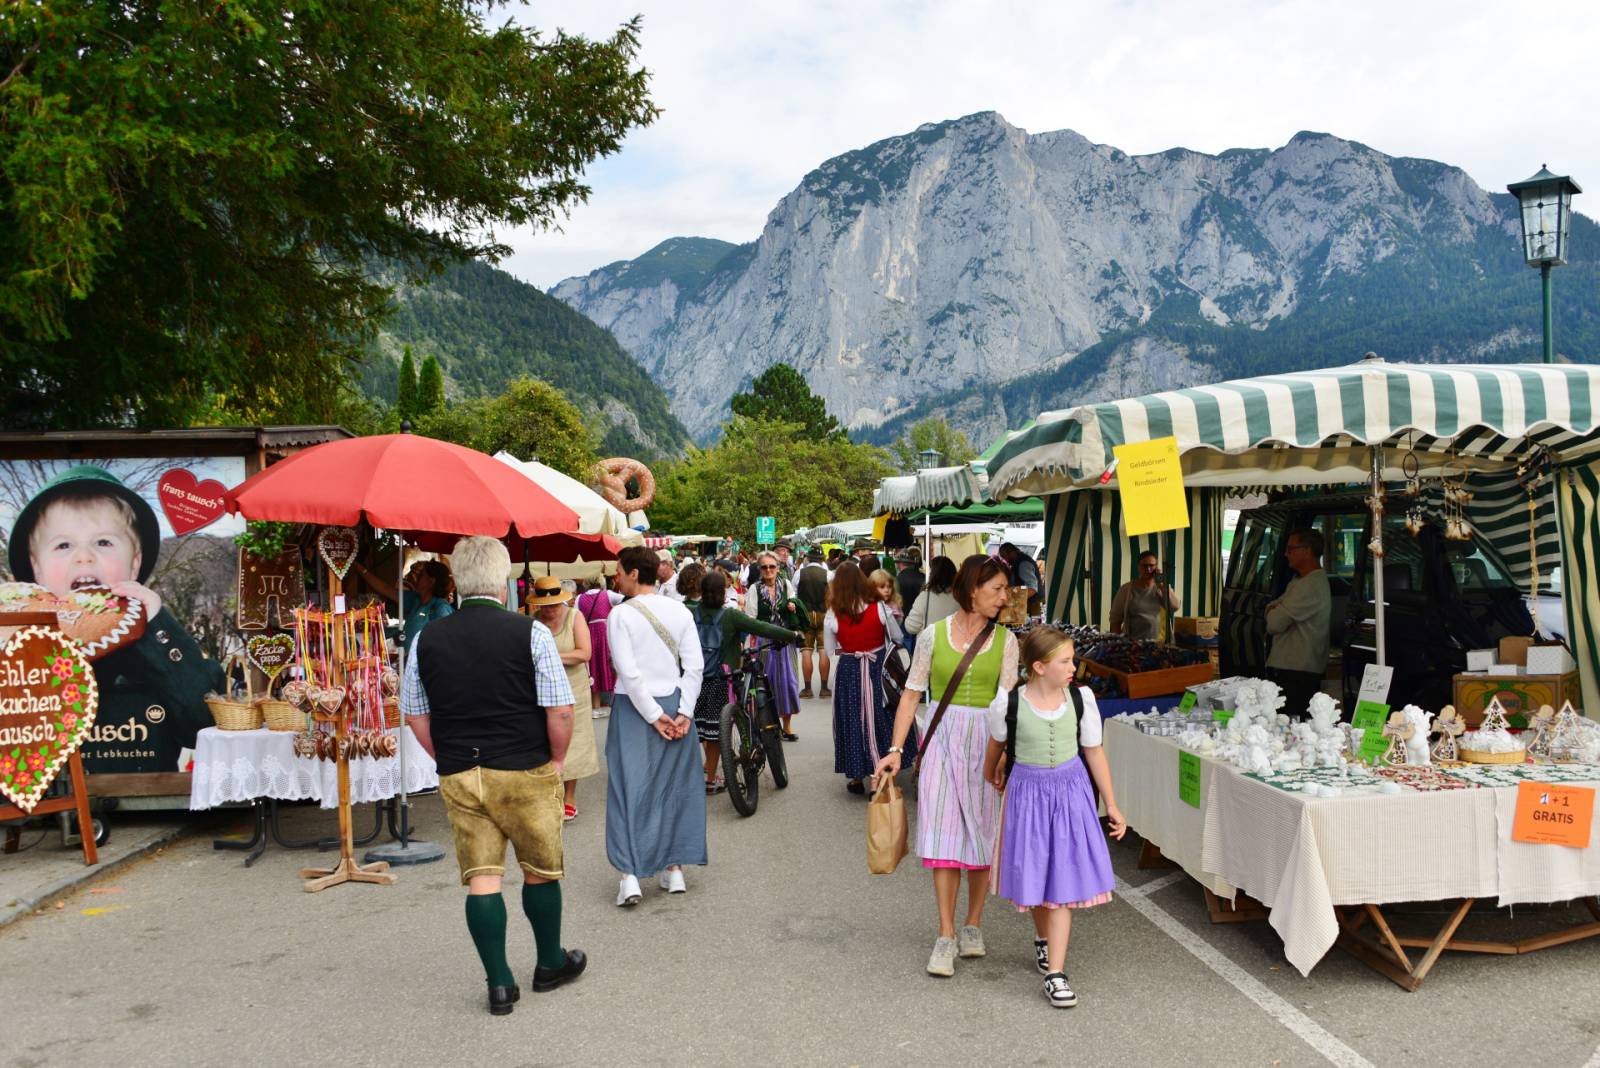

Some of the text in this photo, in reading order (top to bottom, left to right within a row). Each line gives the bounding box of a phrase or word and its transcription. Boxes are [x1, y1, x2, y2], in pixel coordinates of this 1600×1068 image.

[762, 518, 770, 530] P
[96, 749, 156, 758] Lebkuchen
[1562, 796, 1569, 807] 1
[1533, 810, 1574, 824] GRATIS
